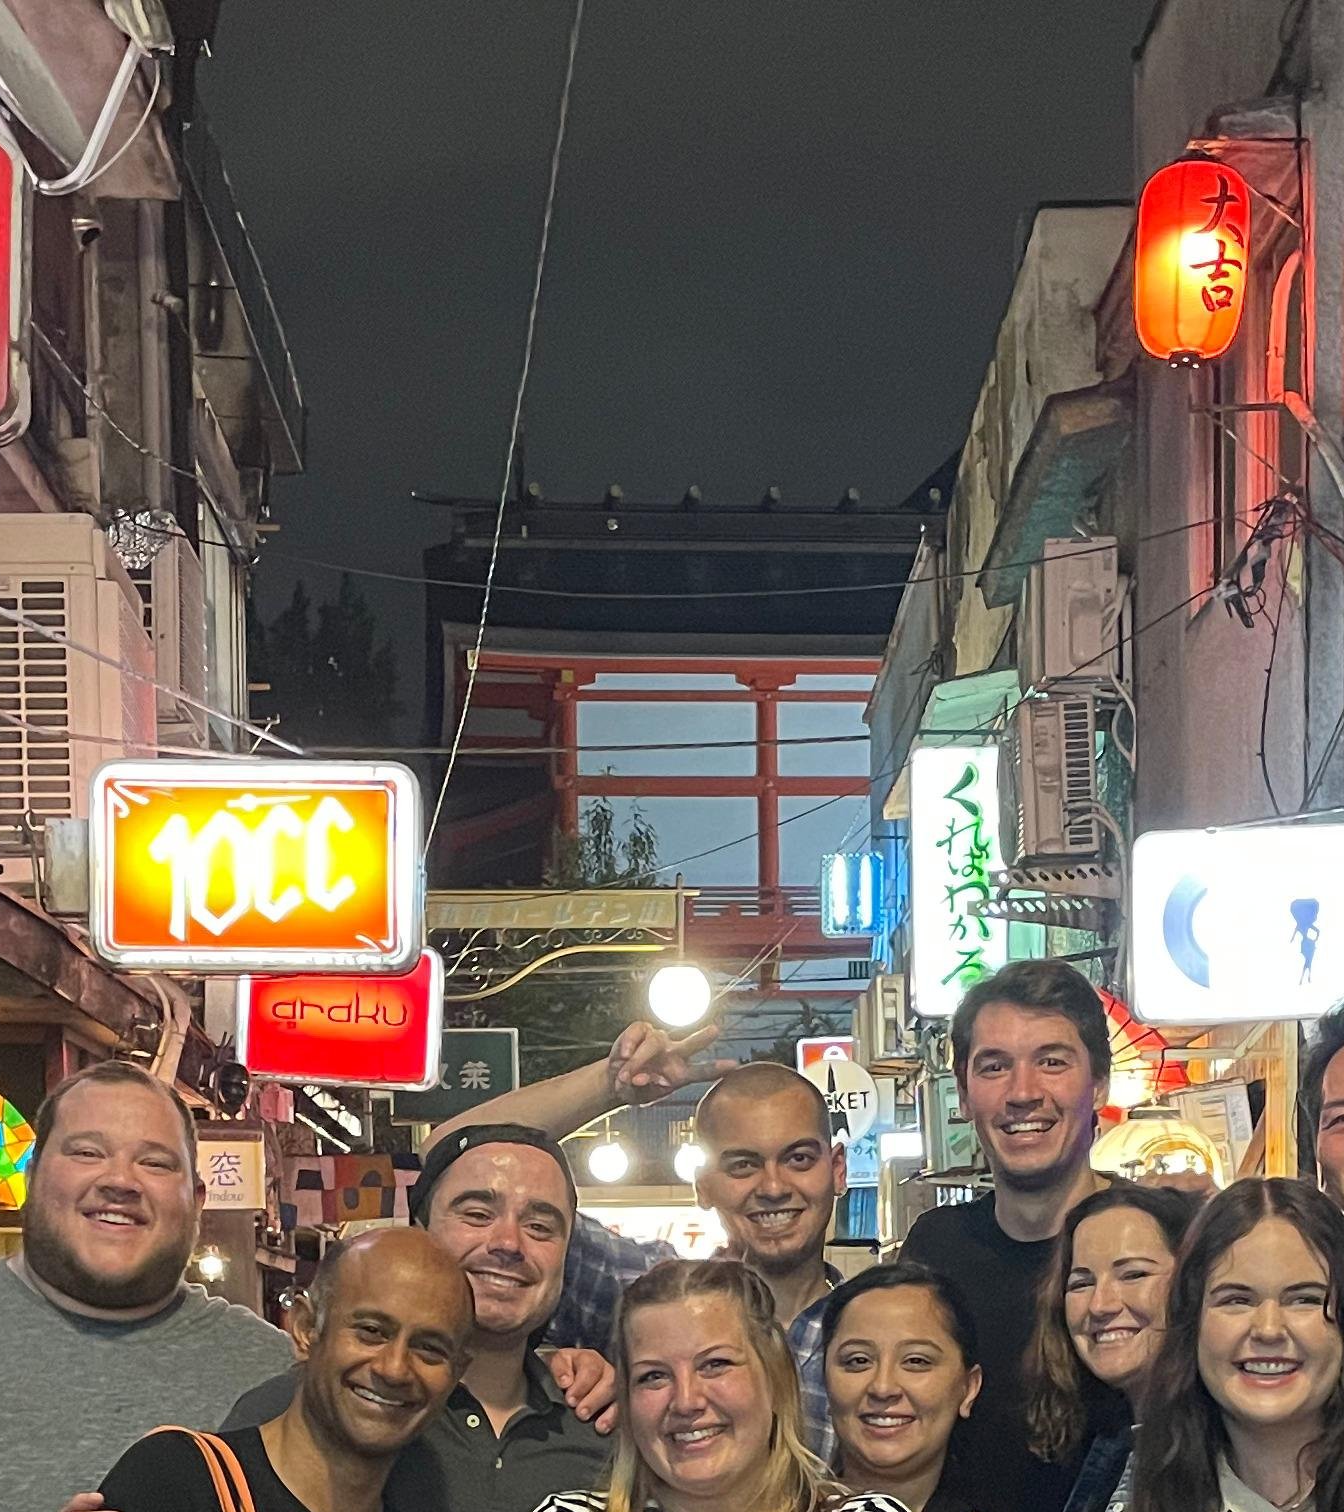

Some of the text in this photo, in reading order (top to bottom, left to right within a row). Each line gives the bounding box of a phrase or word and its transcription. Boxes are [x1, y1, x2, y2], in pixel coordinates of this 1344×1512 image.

[1191, 174, 1245, 312] 大吉
[935, 763, 992, 987] くればわかる
[205, 1189, 245, 1202] indow
[209, 1151, 243, 1186] 窓
